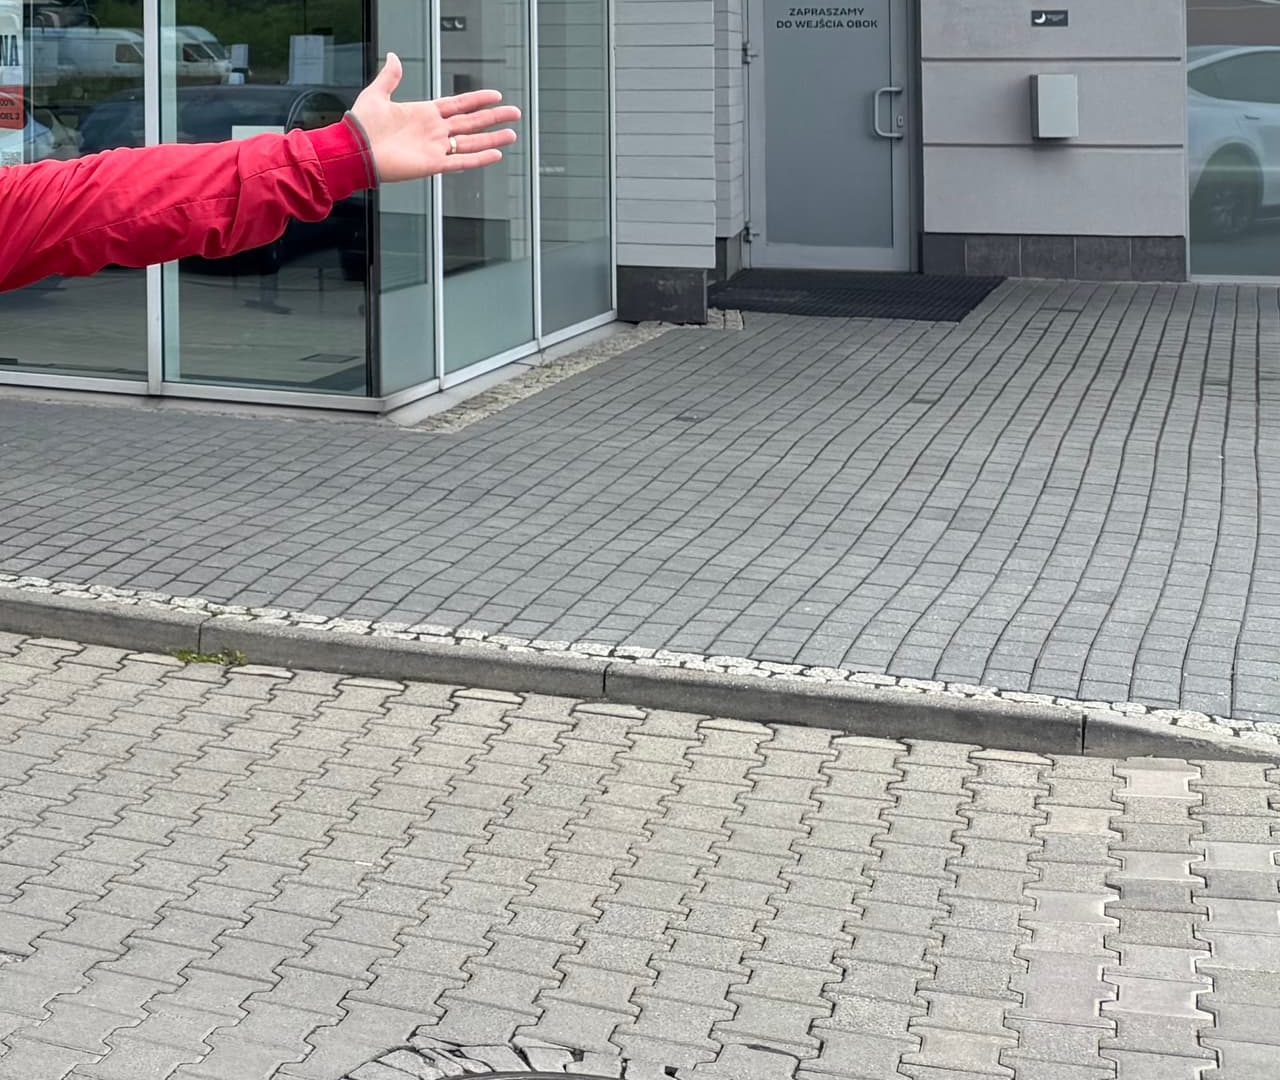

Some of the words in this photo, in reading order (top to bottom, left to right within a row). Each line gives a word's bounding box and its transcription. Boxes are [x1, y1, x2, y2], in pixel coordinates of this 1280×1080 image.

[788, 7, 865, 17] ZAPRASZAMY
[776, 19, 793, 29] DO
[795, 17, 844, 29] WEJŚCIA
[846, 19, 878, 29] OBOK
